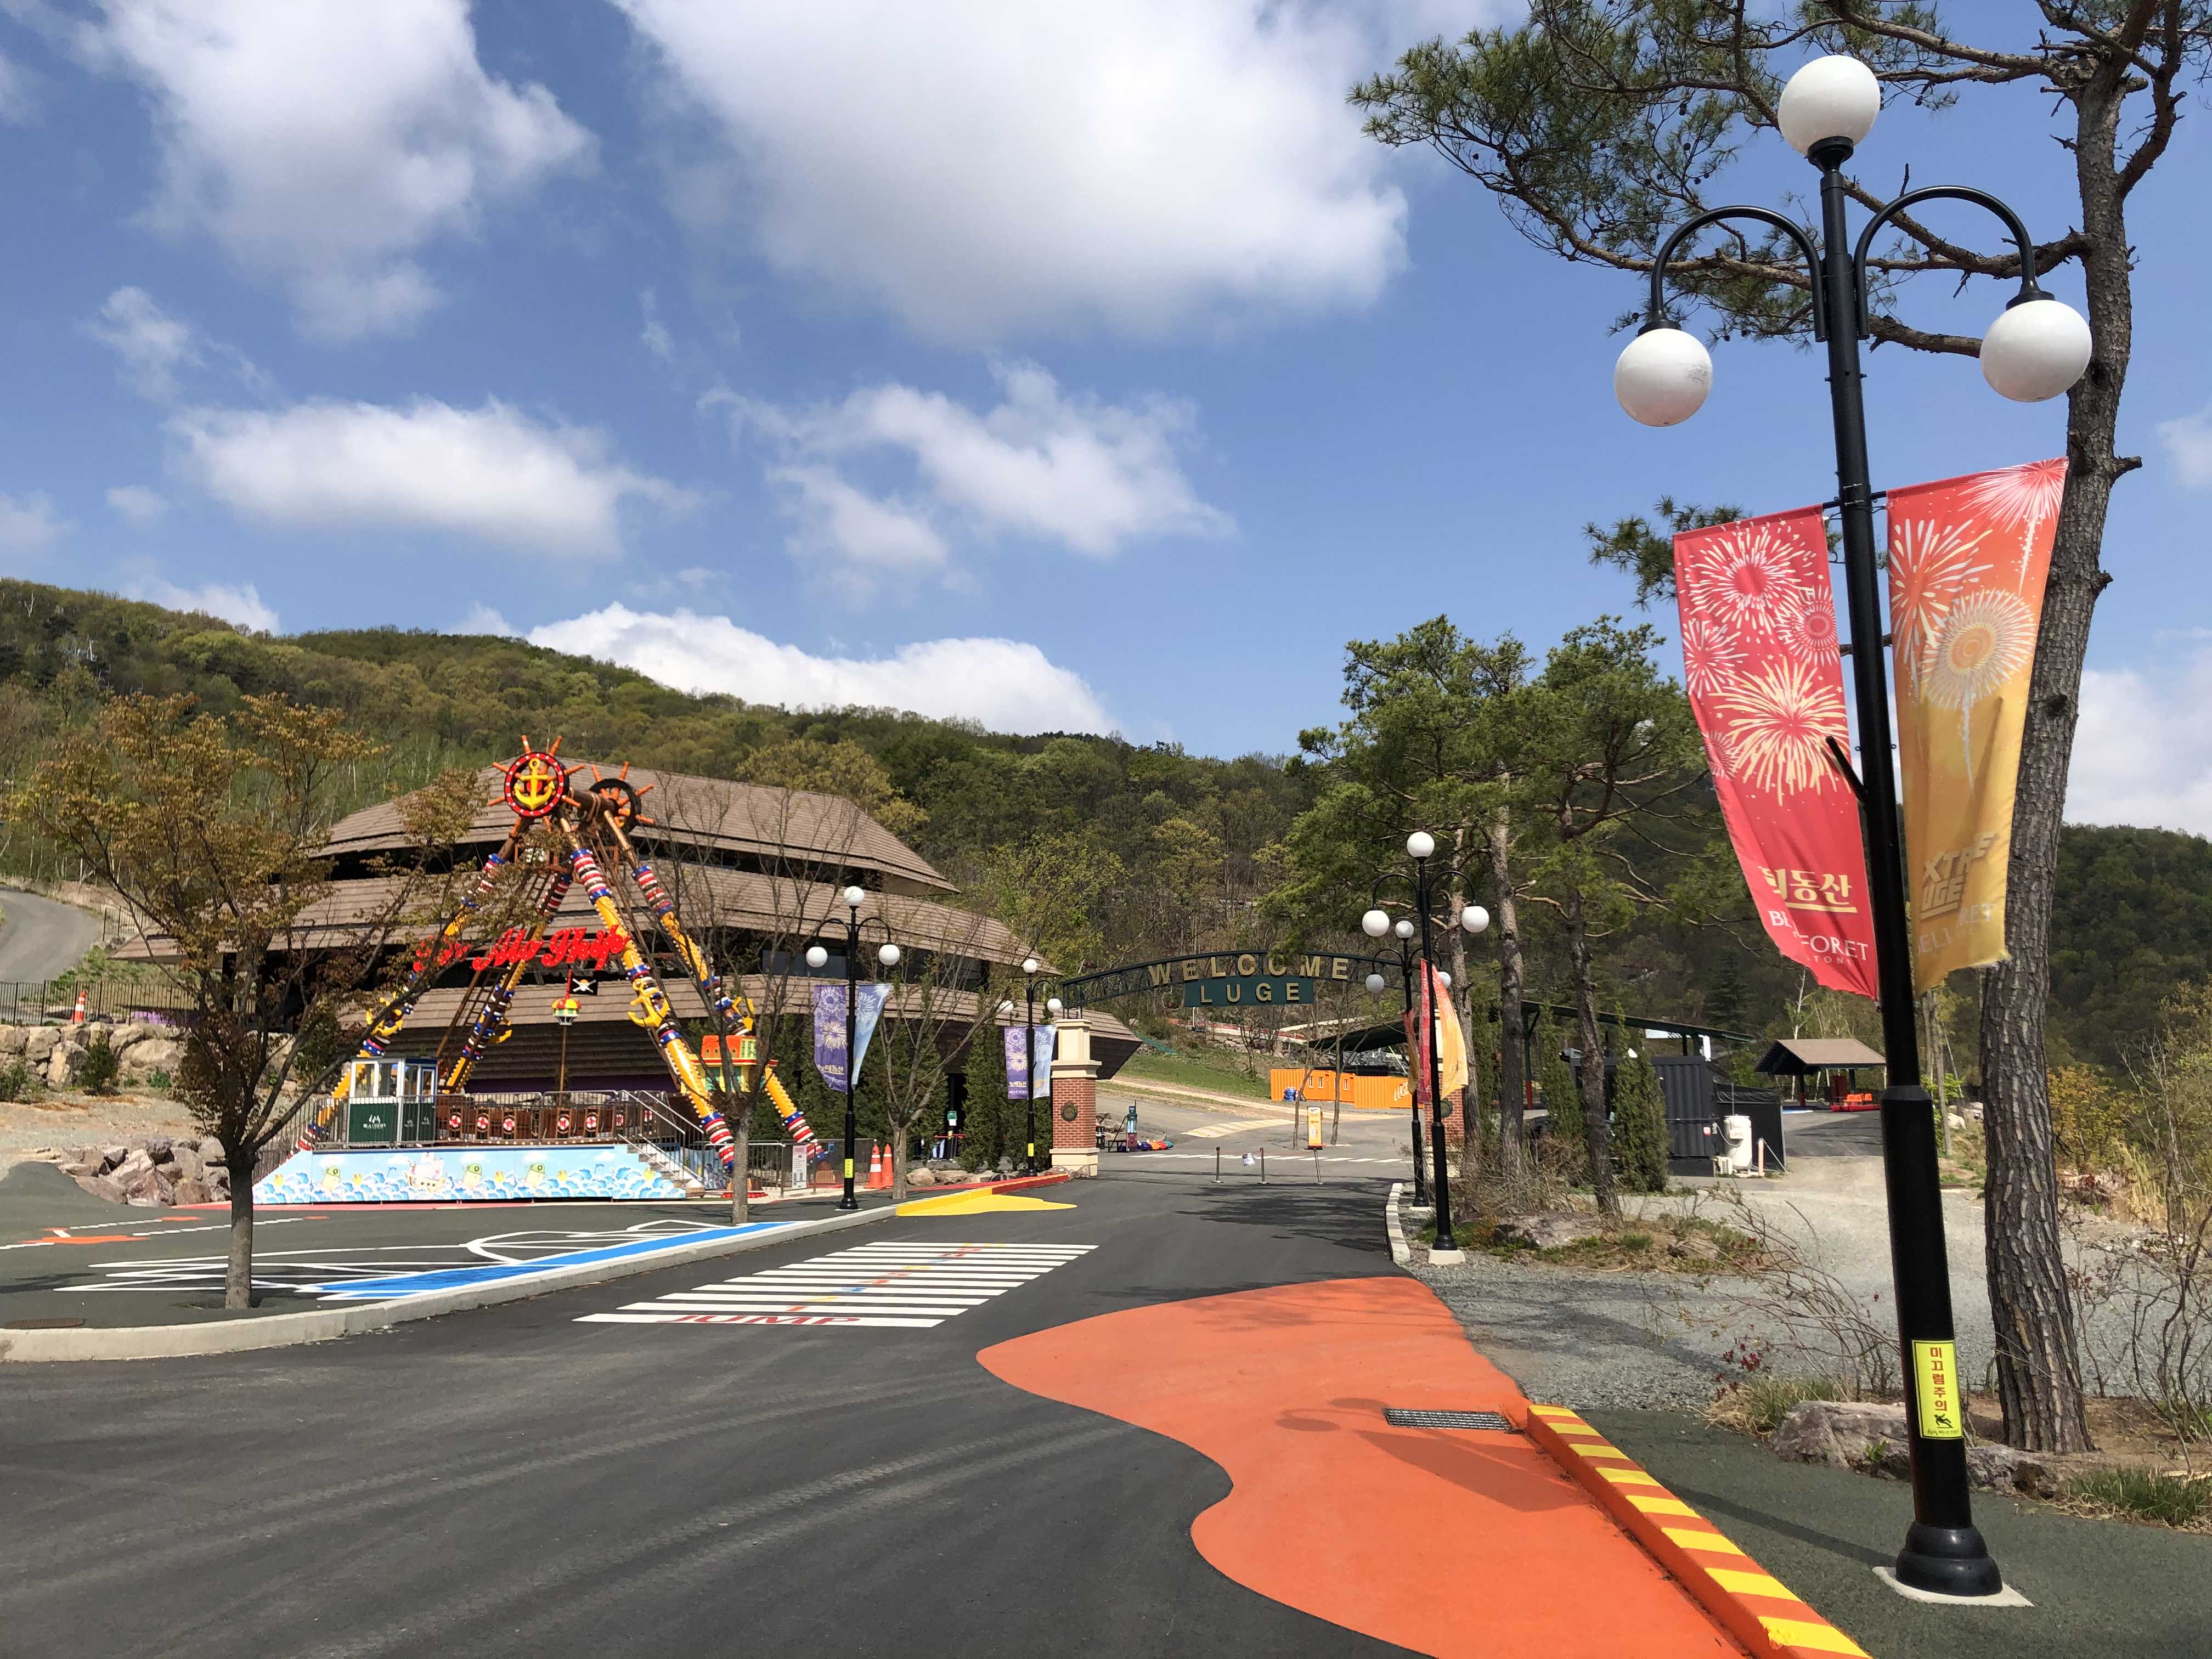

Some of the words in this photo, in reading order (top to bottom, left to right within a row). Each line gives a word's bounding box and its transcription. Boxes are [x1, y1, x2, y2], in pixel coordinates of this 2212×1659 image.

[1148, 953, 1348, 986] WELCOME
[1200, 982, 1300, 1003] LUGE
[657, 1315, 861, 1324] JUMP
[1929, 1347, 1948, 1412] 미끄럼주의
